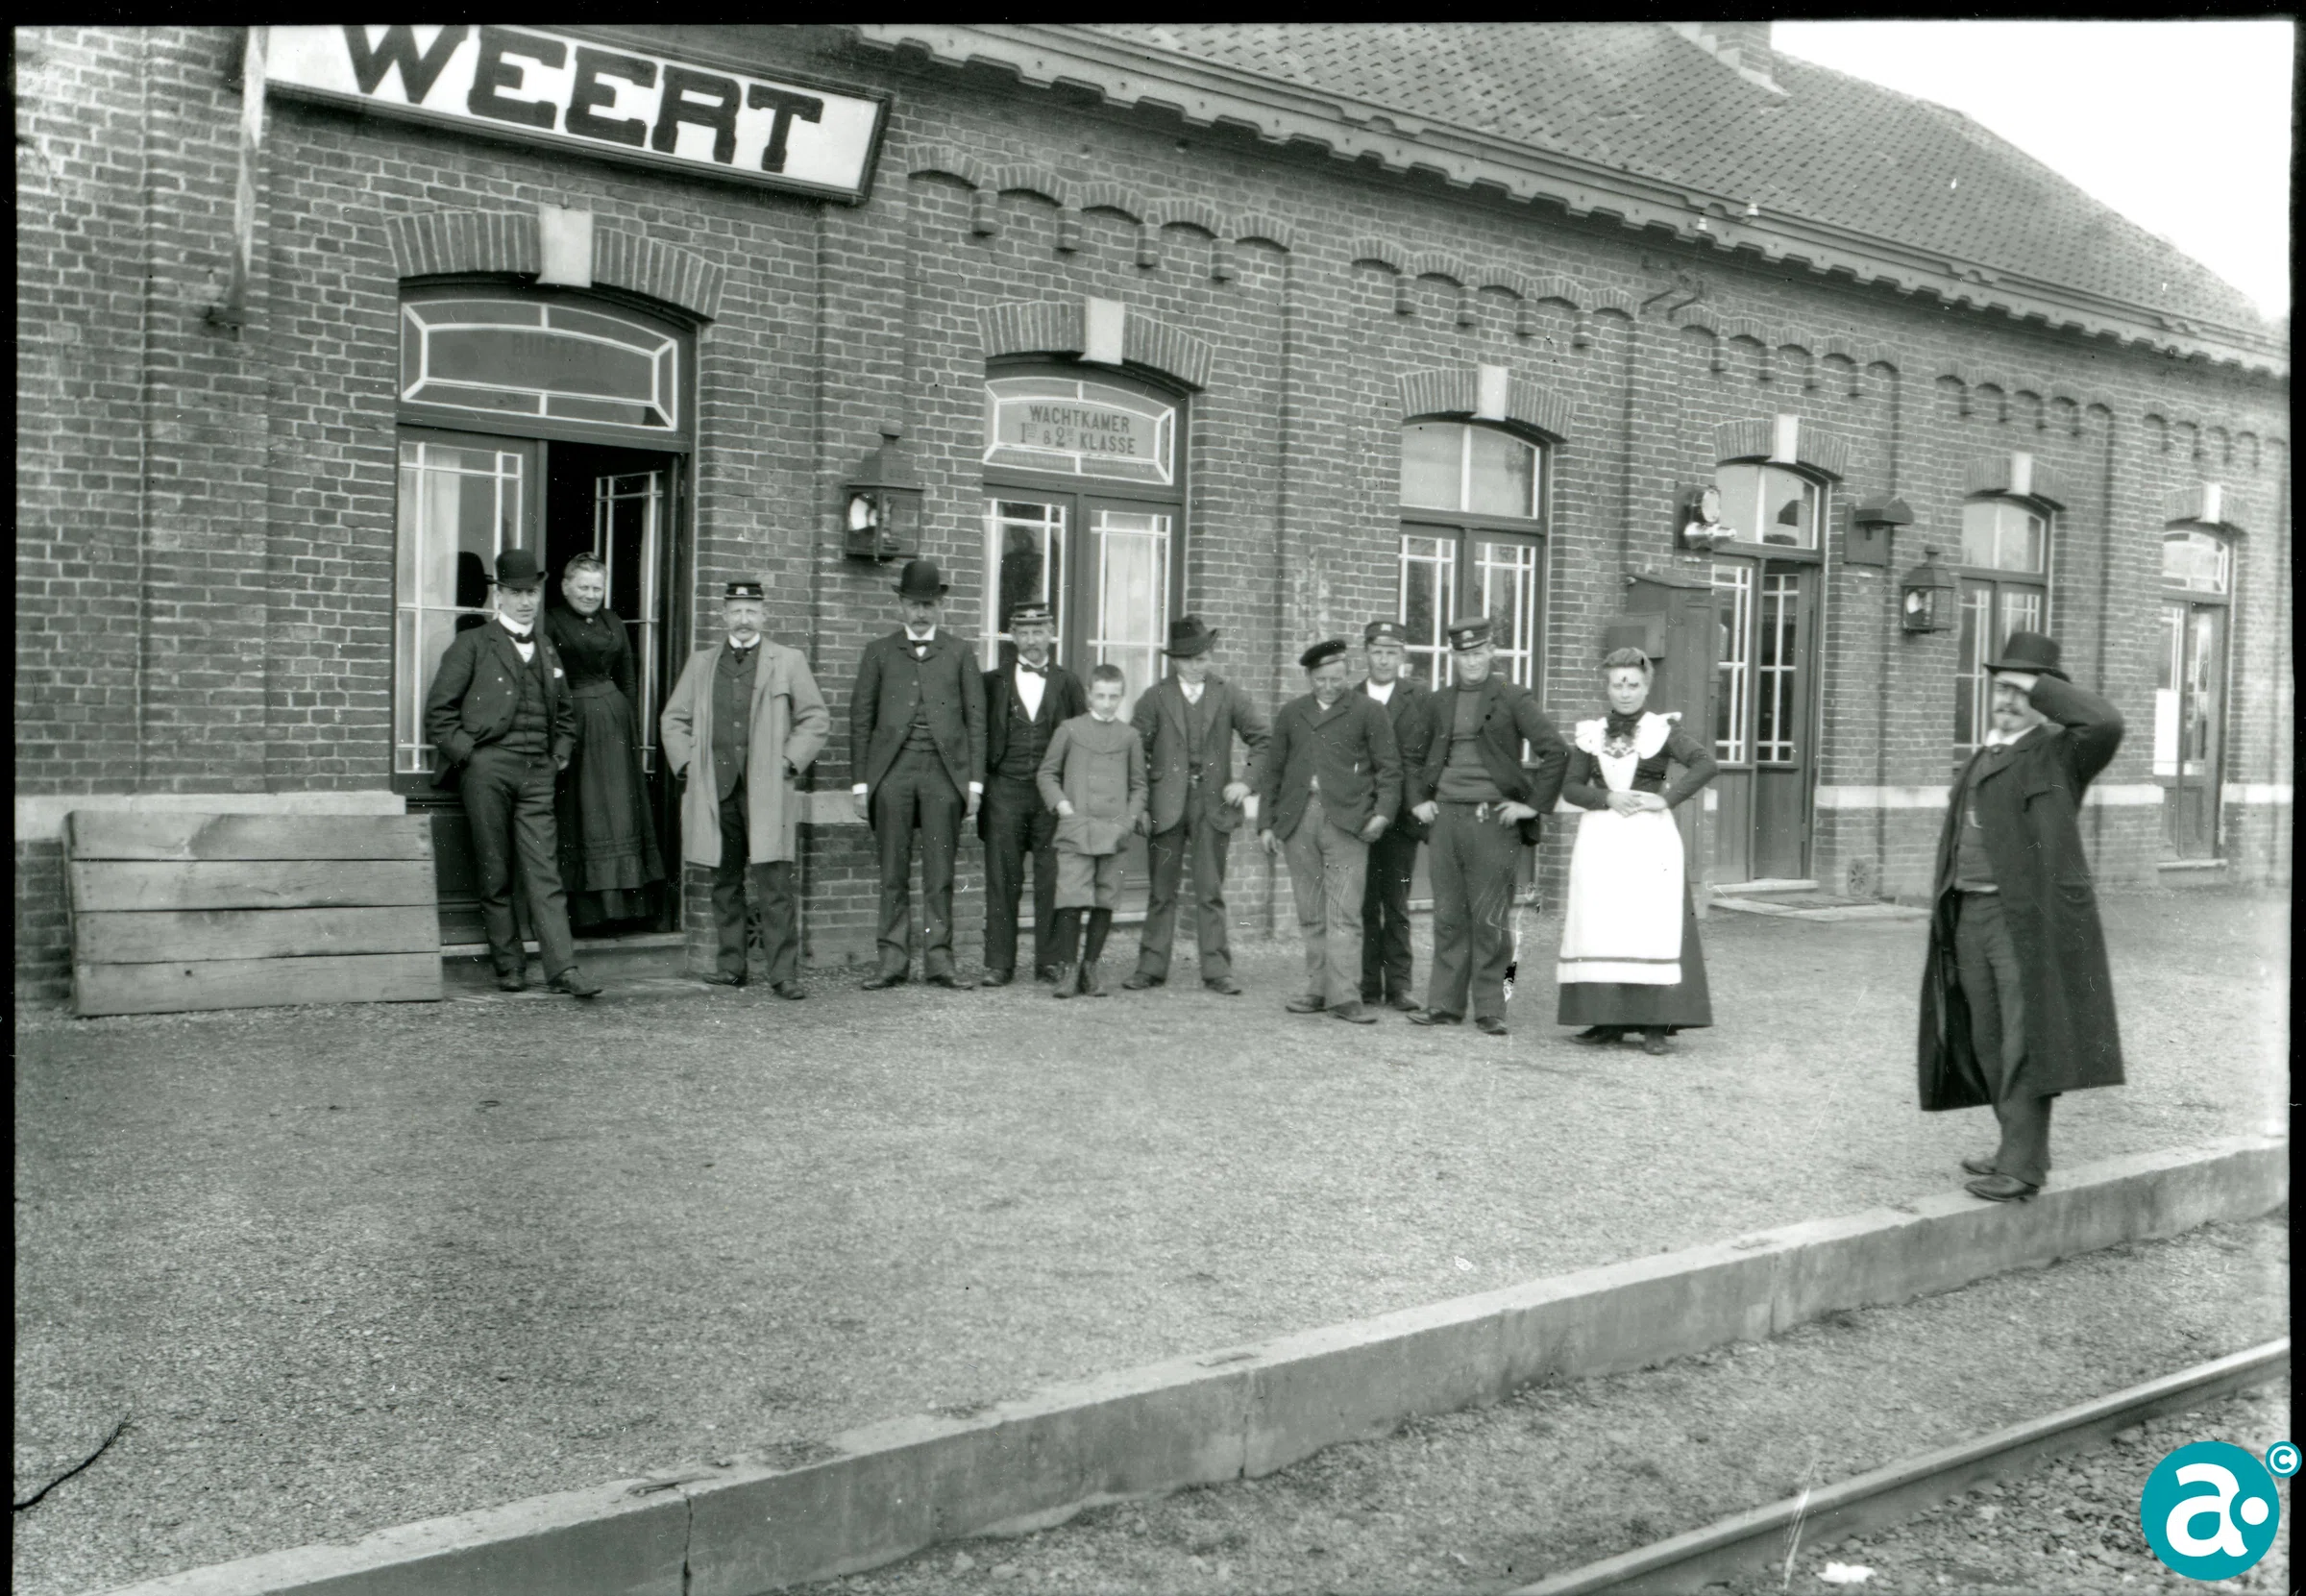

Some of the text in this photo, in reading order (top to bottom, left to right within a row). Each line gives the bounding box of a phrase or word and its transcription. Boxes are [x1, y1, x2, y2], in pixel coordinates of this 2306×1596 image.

[342, 25, 823, 173] WEERT
[1029, 405, 1131, 433] WACHTKAMER
[1080, 431, 1137, 455] KLASSE
